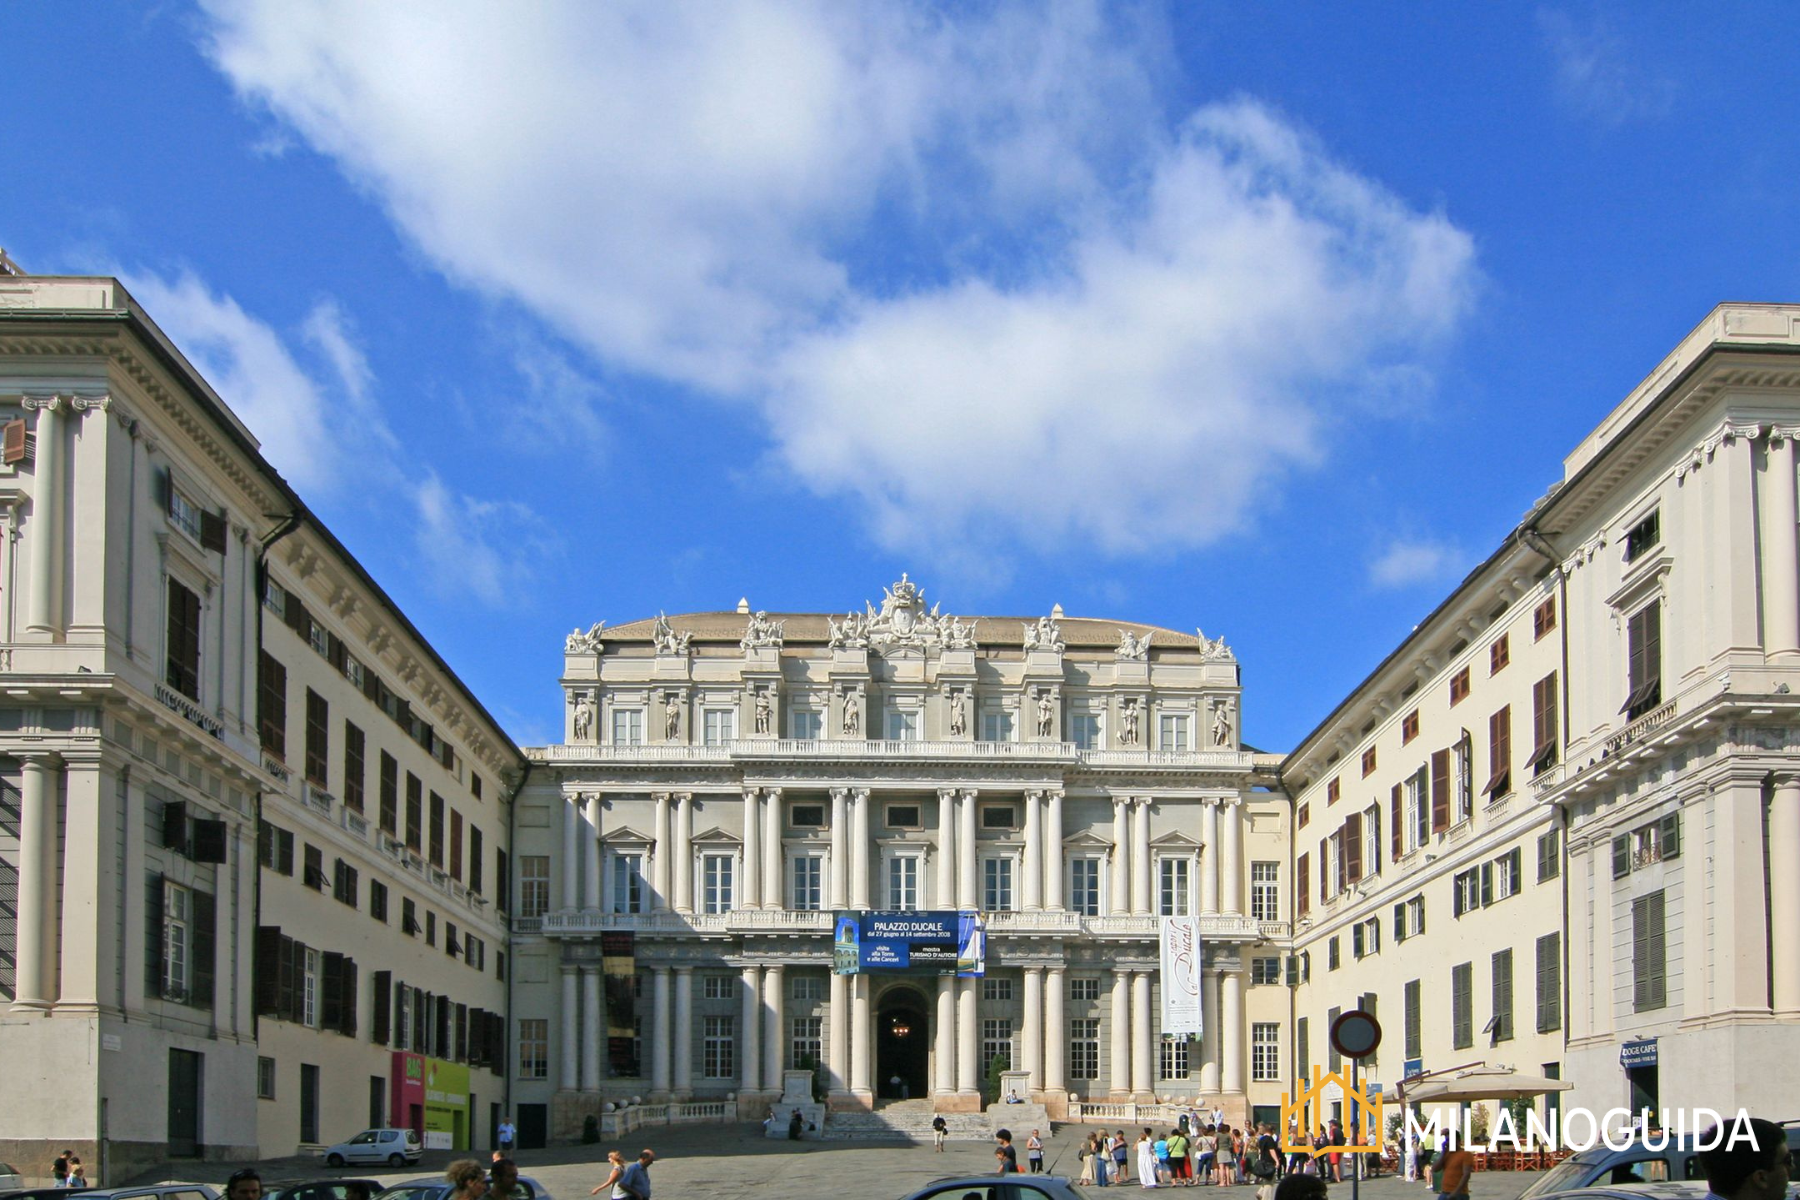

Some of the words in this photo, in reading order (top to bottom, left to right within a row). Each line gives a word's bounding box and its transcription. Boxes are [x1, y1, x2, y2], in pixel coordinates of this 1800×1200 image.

[874, 922, 909, 931] PALAZZO
[911, 922, 942, 931] DUCALE
[1622, 1047, 1640, 1056] DOGE
[407, 1057, 421, 1079] BAG
